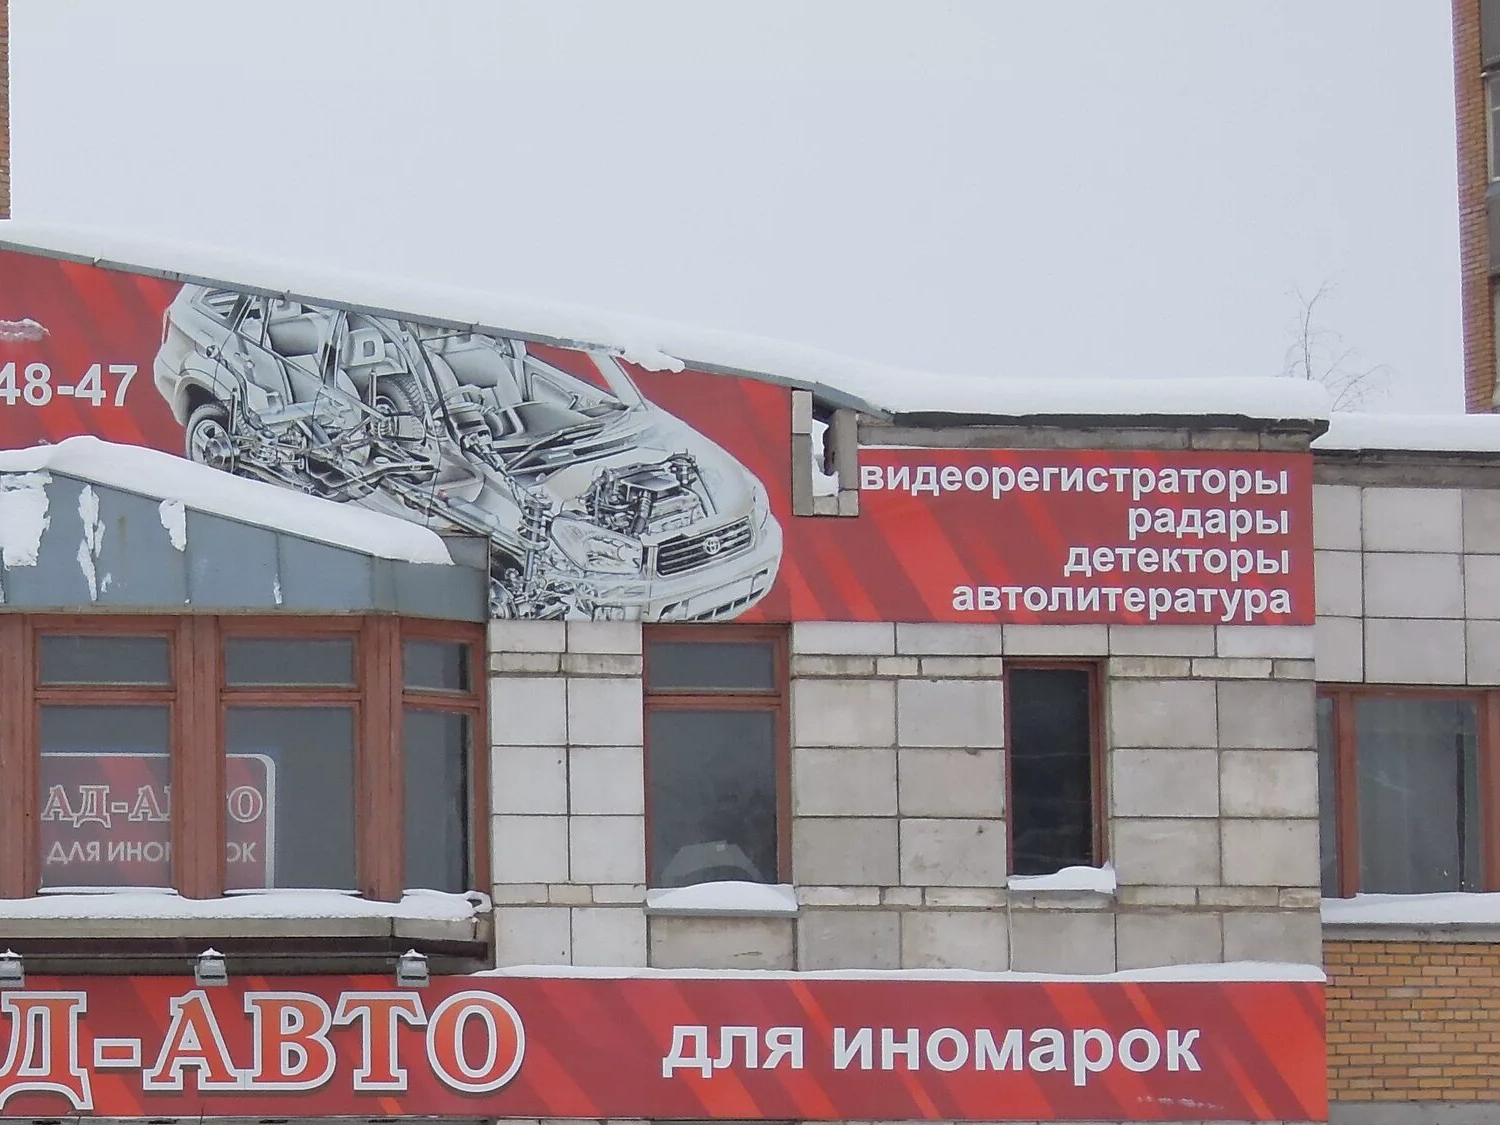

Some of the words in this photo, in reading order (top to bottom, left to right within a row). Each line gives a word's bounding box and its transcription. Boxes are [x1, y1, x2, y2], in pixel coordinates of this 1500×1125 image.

[860, 465, 1288, 503] видеорегистраторы
[1128, 507, 1289, 542] радары
[1064, 546, 1289, 582] детекторы
[952, 585, 1291, 622] автолитература
[46, 840, 100, 865] ДЛЯ
[662, 1025, 804, 1078] для
[833, 1028, 1201, 1087] иномарок
